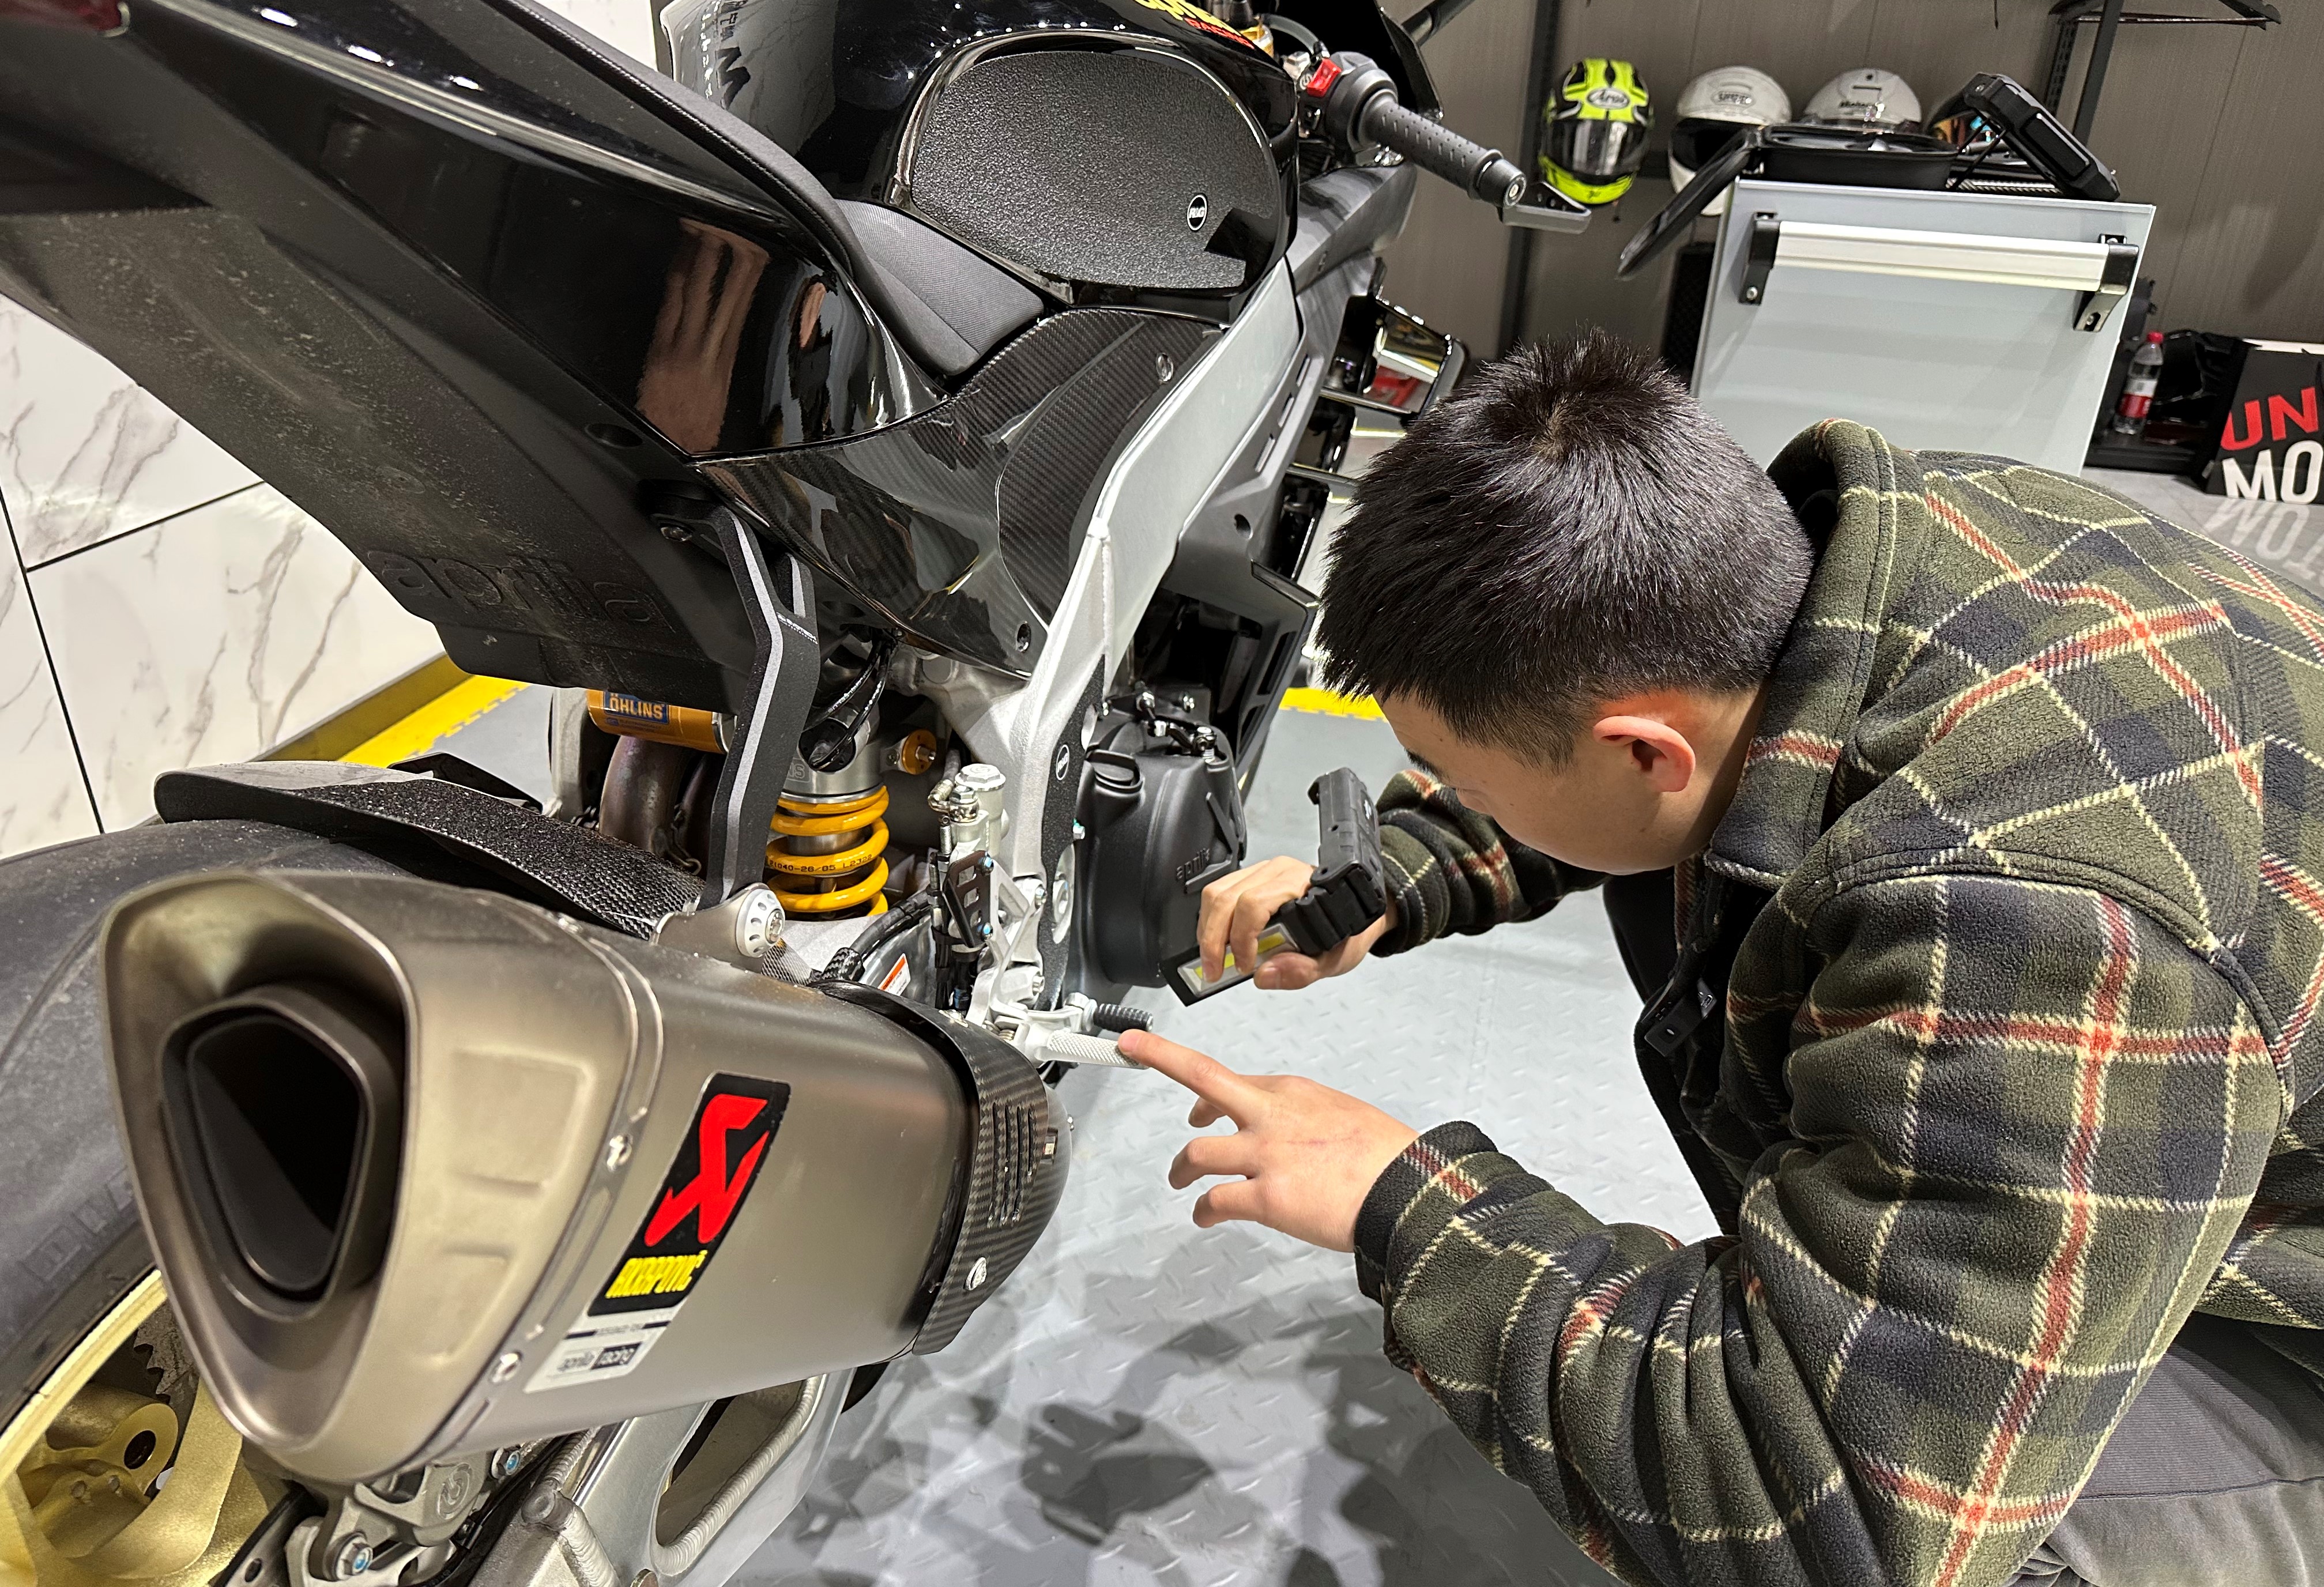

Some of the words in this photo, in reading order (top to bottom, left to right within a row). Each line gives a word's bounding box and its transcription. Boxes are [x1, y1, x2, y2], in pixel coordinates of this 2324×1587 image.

[2220, 387, 2319, 451] UN
[2222, 440, 2323, 505] MO
[609, 692, 664, 720] ÖHLINS
